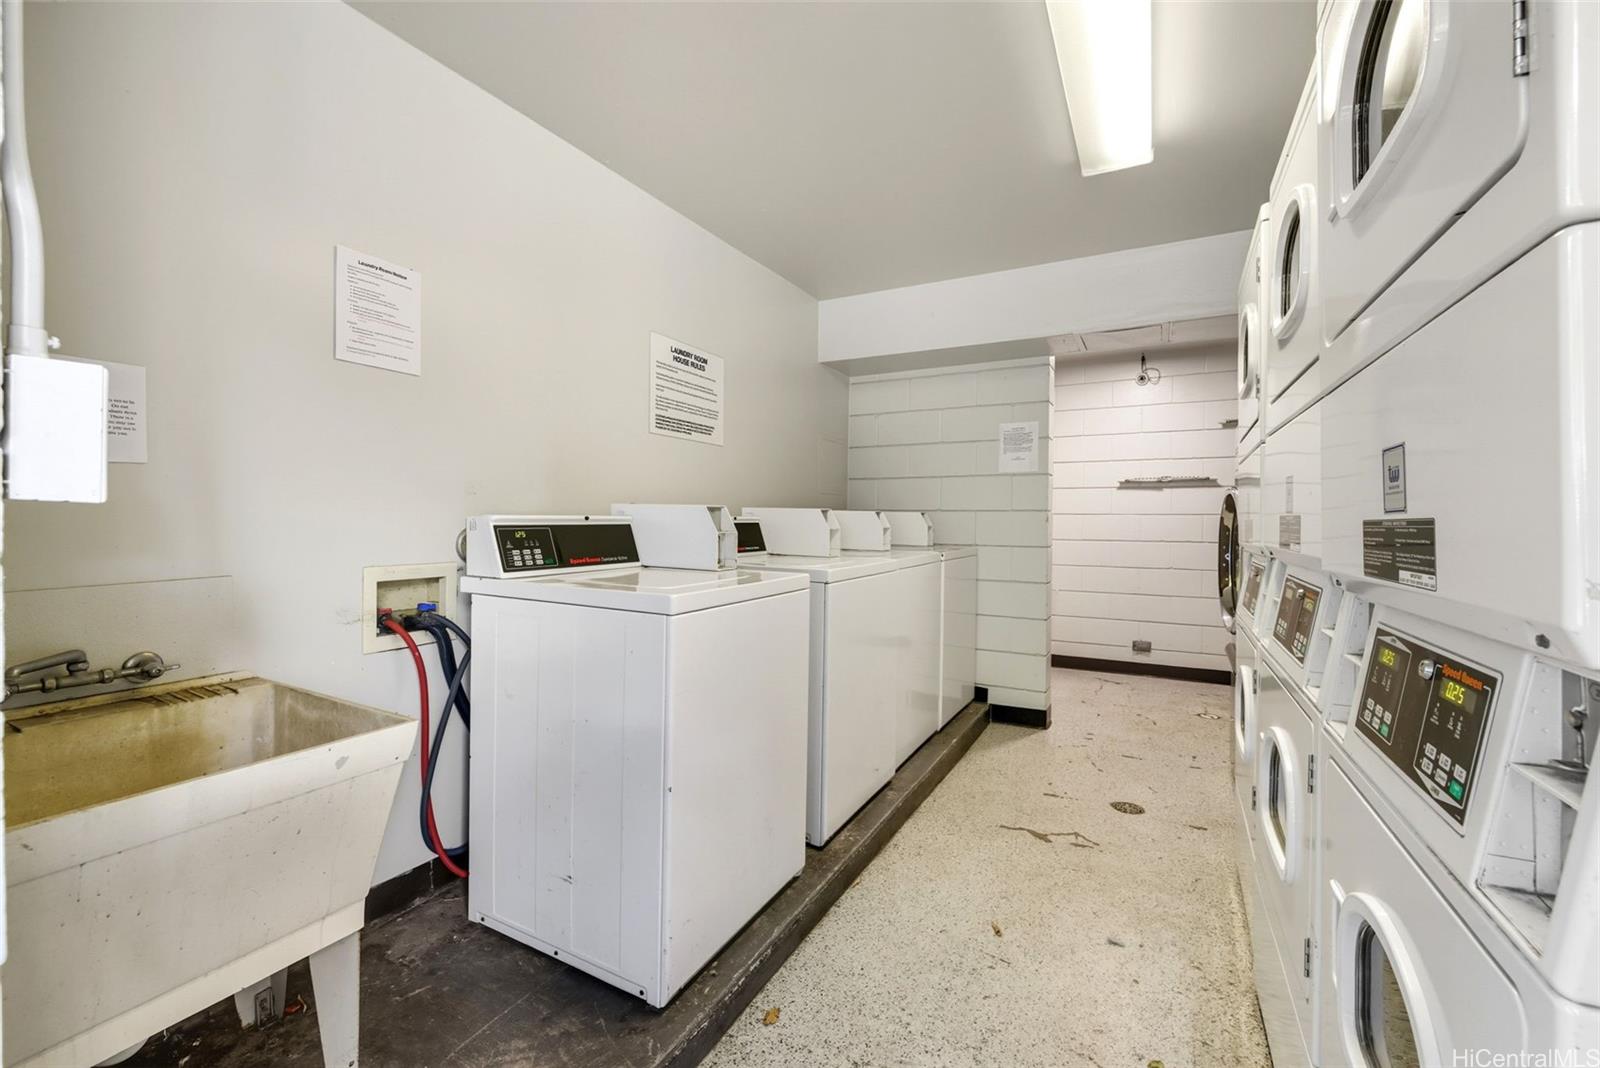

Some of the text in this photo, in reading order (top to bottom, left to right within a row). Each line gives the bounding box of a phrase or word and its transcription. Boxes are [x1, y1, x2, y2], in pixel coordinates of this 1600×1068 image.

[670, 346, 708, 365] LAUNDRY ROOM
[672, 355, 706, 372] HOUSE RULES
[1442, 664, 1483, 690] Speed Queen
